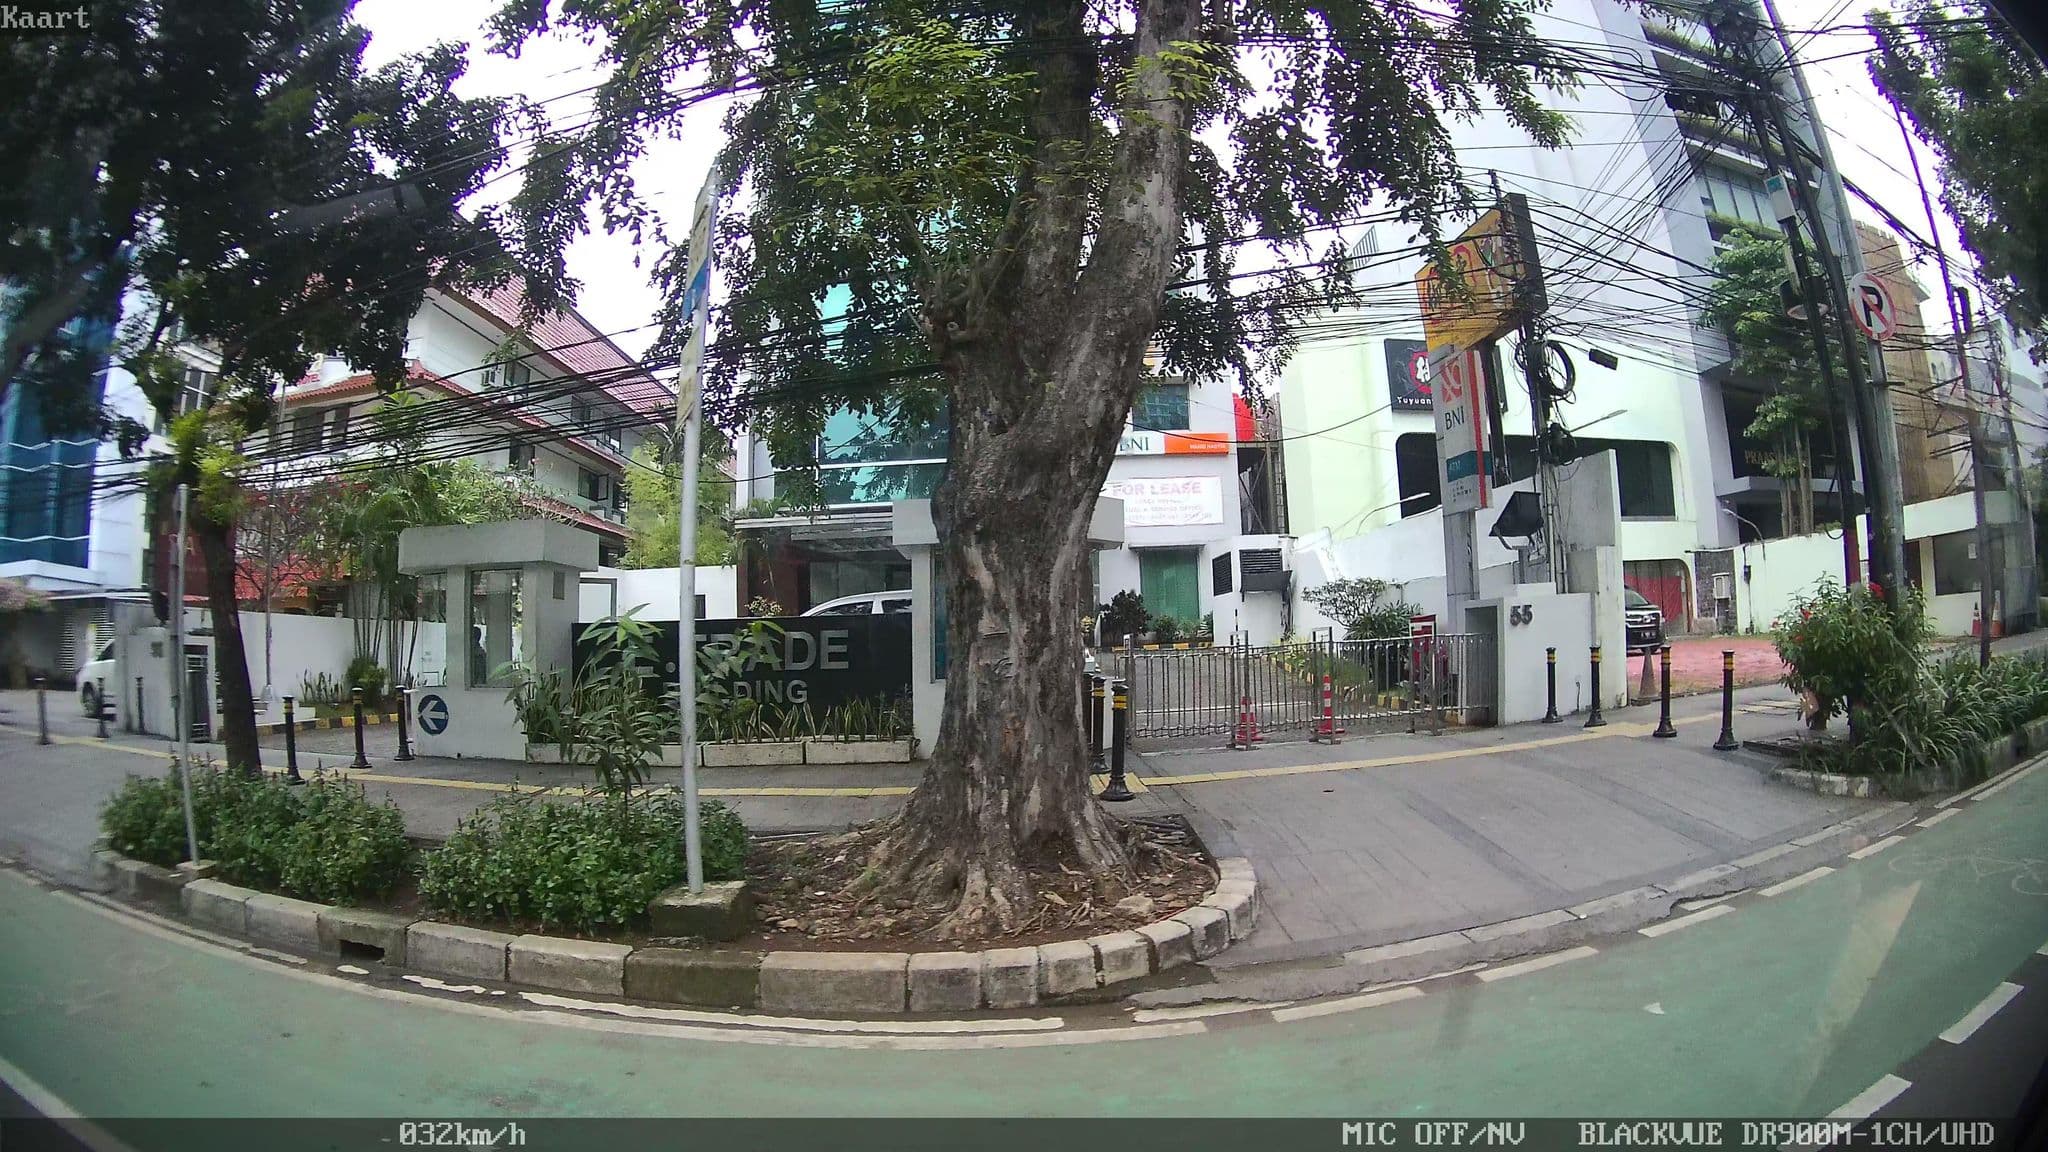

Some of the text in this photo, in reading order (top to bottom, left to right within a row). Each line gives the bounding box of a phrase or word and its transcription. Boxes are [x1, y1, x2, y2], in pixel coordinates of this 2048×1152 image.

[1859, 285, 1883, 327] P
[1445, 405, 1465, 431] BNI
[1119, 436, 1149, 452] BNI
[1112, 482, 1203, 496] FOR LEASE
[1510, 604, 1533, 626] 55
